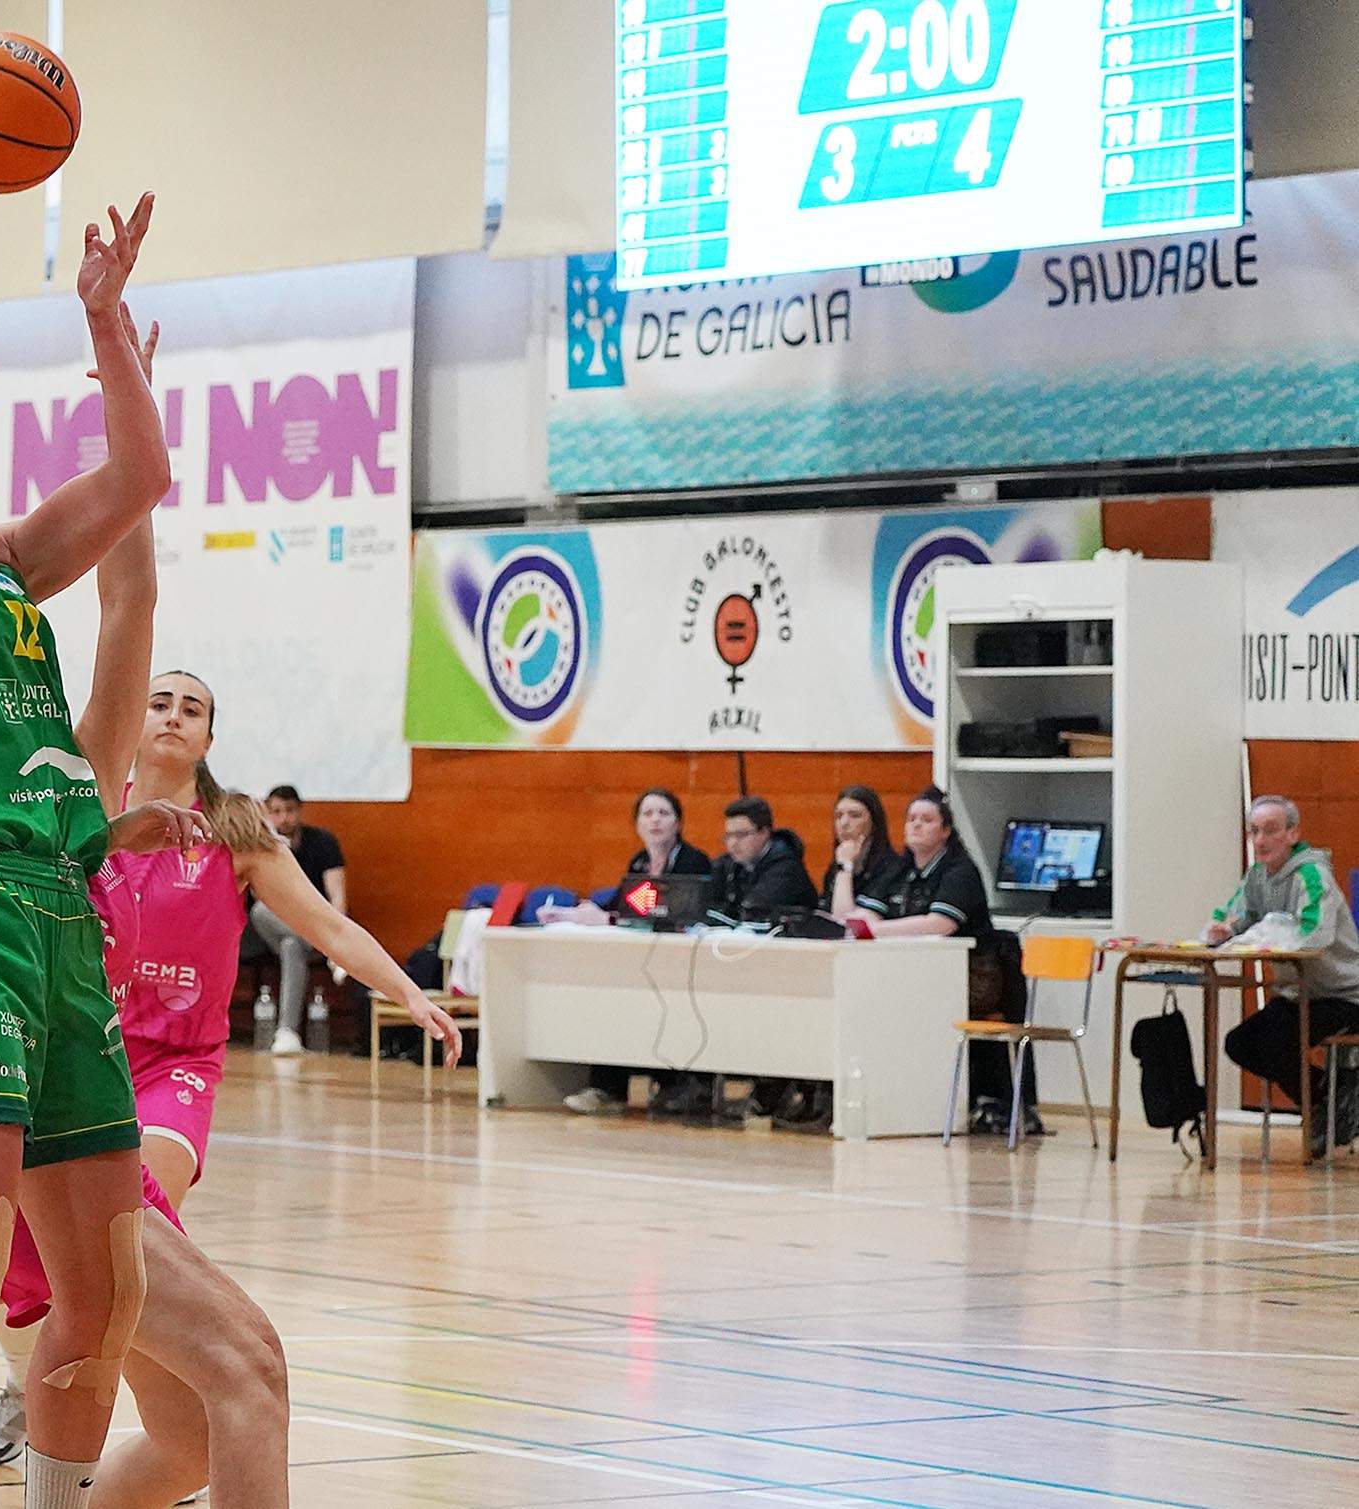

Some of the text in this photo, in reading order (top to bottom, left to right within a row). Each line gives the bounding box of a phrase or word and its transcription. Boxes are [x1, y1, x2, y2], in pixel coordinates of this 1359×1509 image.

[846, 0, 991, 101] 2:00
[820, 125, 858, 203] 3
[952, 106, 993, 185] 4
[1044, 233, 1259, 308] SAUDABLE
[636, 287, 851, 361] DE GALICIA
[3, 599, 46, 661] 12
[702, 535, 794, 645] BALONCESTO
